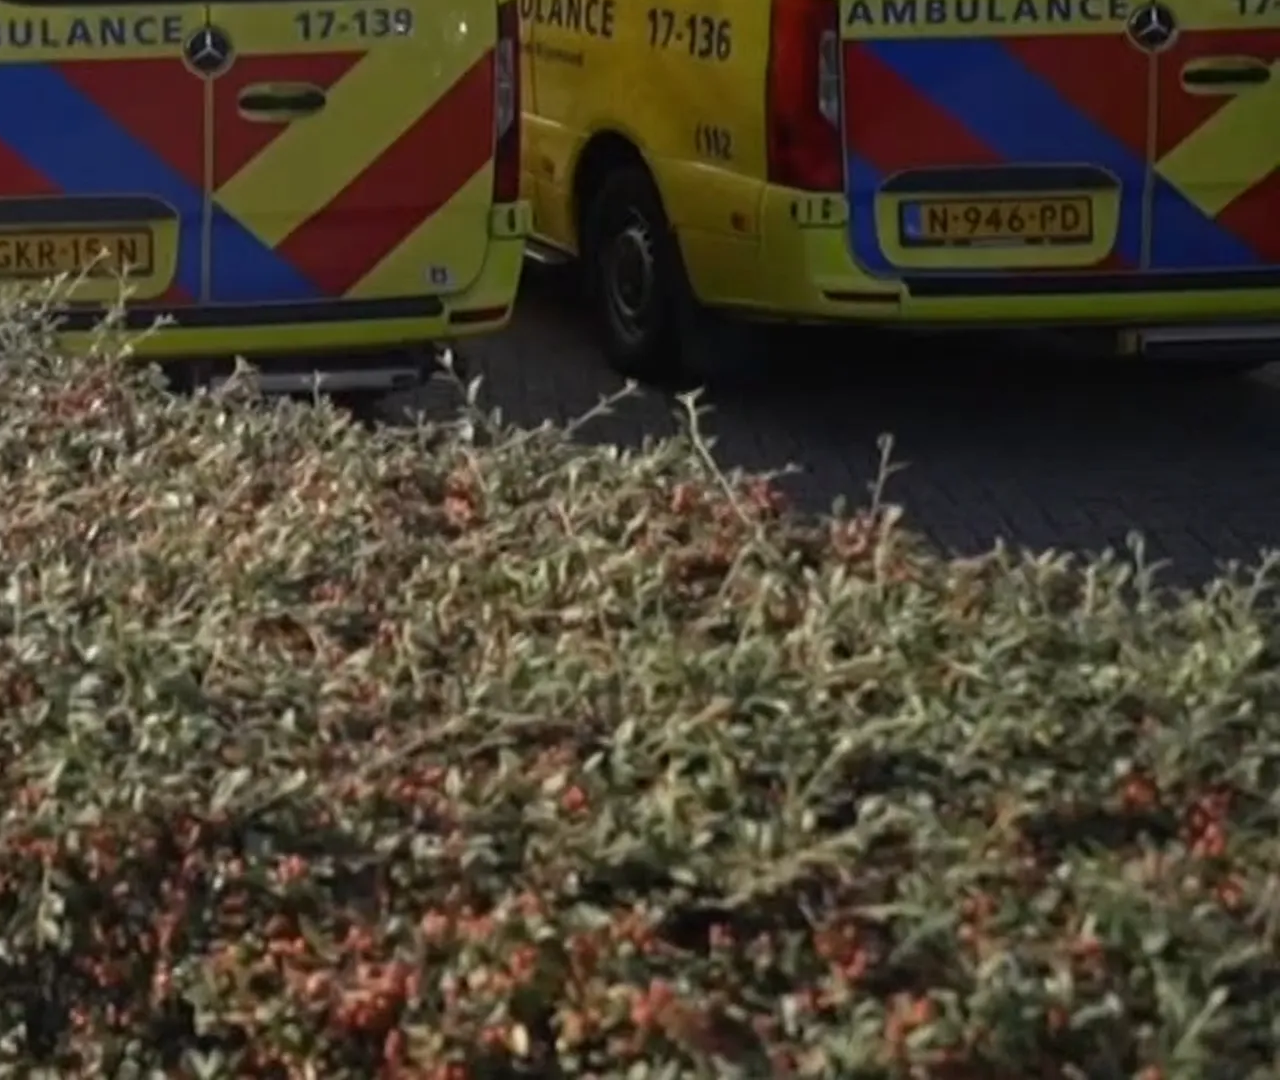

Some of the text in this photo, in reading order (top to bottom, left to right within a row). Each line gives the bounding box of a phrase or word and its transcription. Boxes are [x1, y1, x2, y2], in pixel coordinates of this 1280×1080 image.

[294, 8, 414, 41] 17-139
[647, 8, 732, 62] 17-136
[927, 203, 1081, 234] N-946-PD
